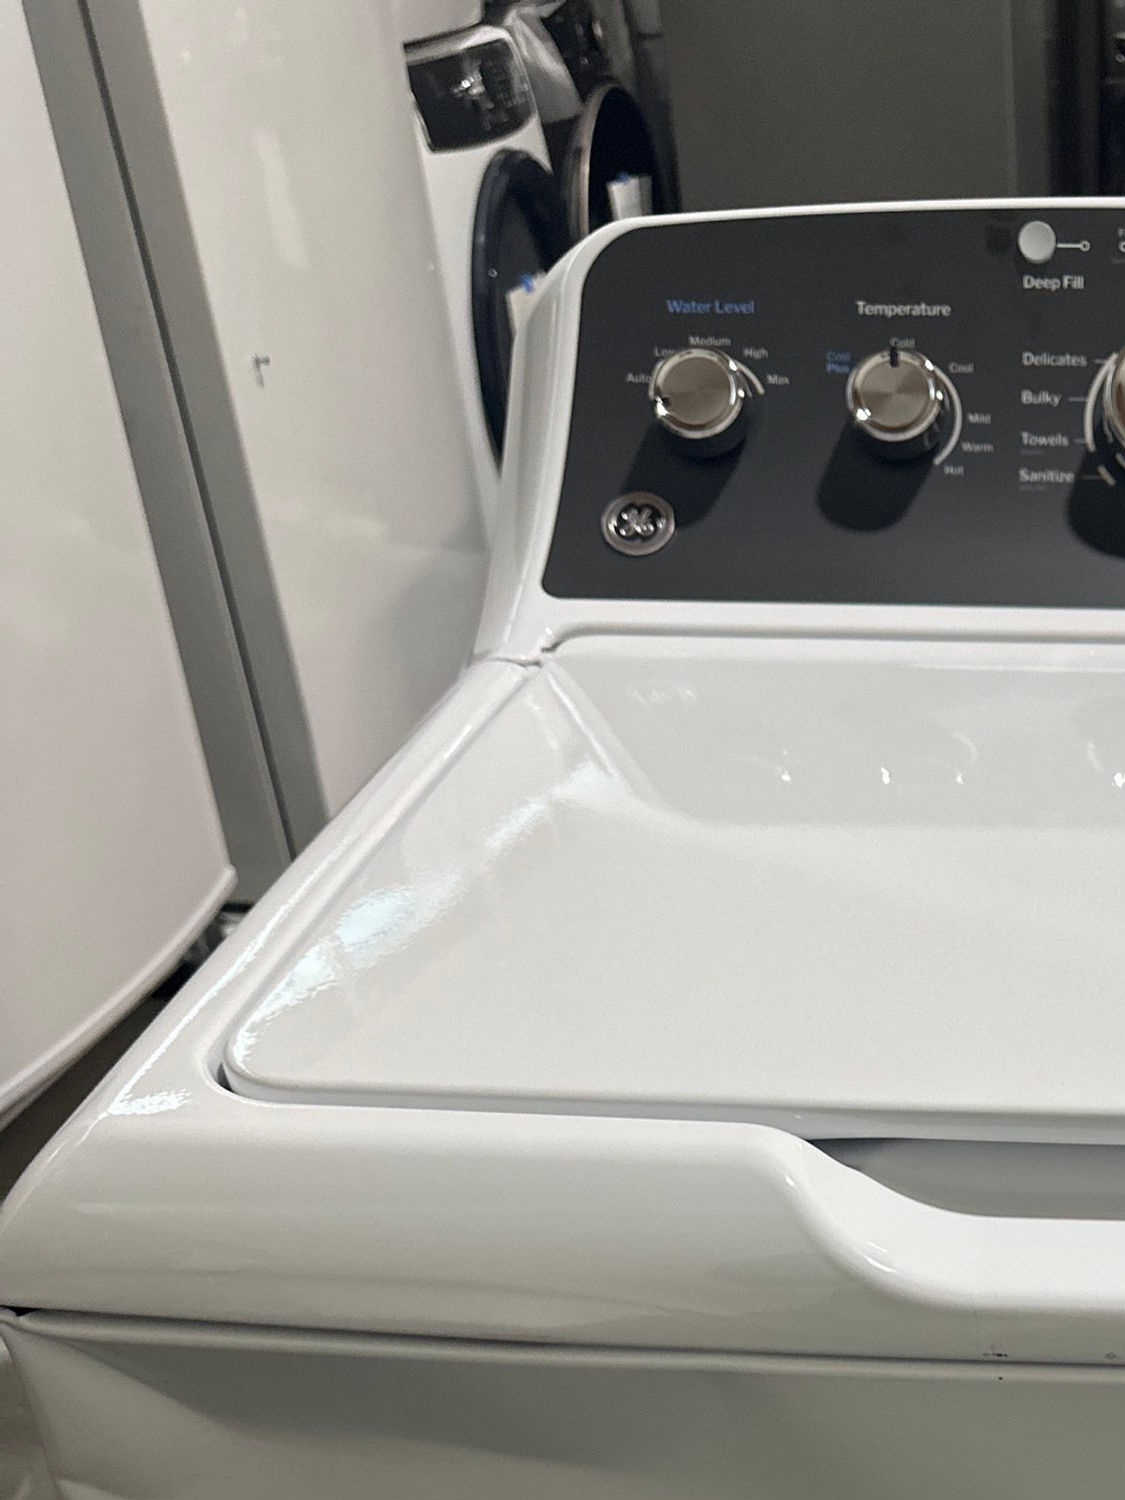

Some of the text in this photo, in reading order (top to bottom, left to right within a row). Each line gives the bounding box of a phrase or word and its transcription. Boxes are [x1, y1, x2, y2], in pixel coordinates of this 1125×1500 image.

[1023, 275, 1084, 291] Deep Fill
[666, 300, 756, 314] Water Level
[856, 301, 952, 317] Temperature
[688, 336, 731, 346] Medium
[889, 337, 915, 349] Cold
[743, 348, 768, 359] High
[1022, 352, 1087, 366] Delicates
[626, 373, 653, 383] Auto
[767, 374, 790, 384] Max
[1021, 391, 1061, 405] Bulky
[1021, 433, 1069, 446] Towels
[961, 442, 993, 452] Warm
[1018, 469, 1075, 483] Sanitize
